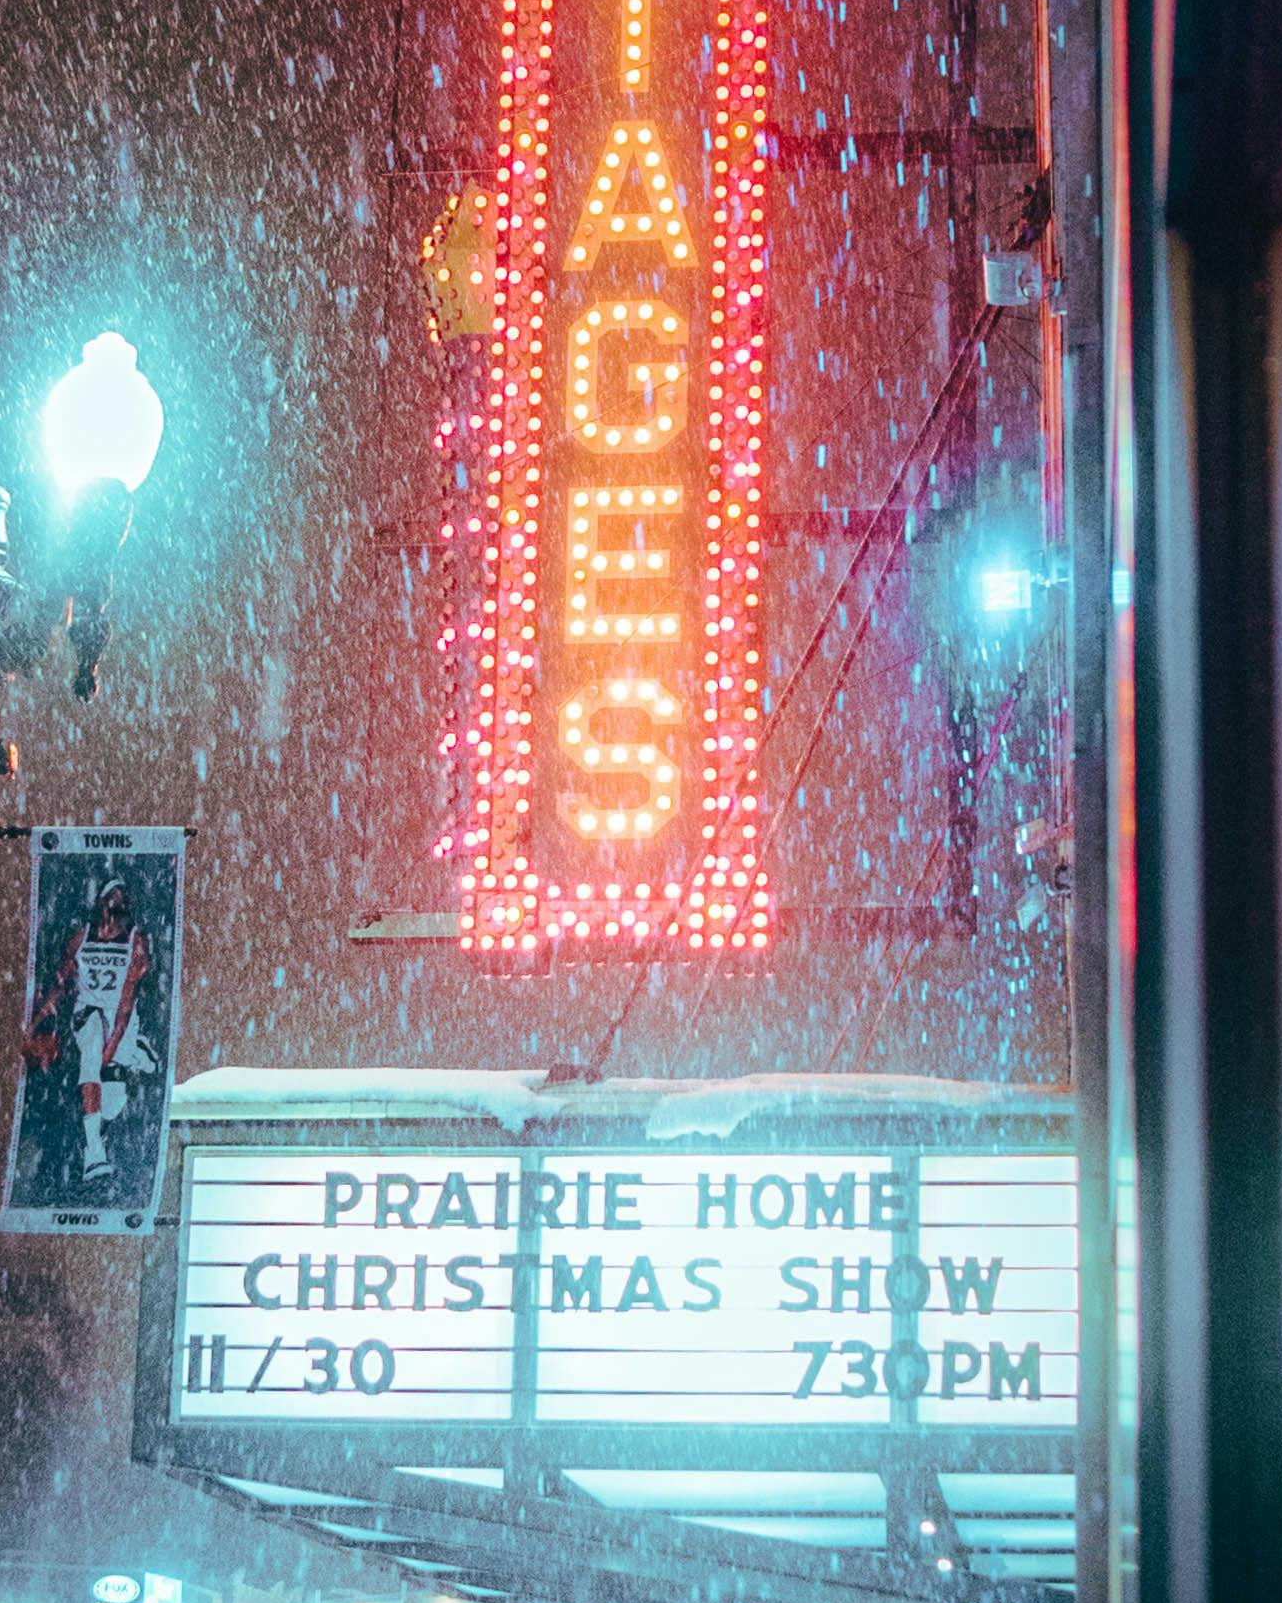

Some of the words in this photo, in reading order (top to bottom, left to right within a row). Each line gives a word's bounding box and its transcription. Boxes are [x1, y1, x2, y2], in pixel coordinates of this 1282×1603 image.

[83, 832, 134, 849] TOWNS
[81, 953, 128, 969] WOLVES
[87, 969, 118, 991] 32
[322, 1171, 643, 1231] PRAIRIE
[697, 1172, 911, 1231] HOME
[50, 1212, 100, 1227] TOWNS
[243, 1252, 722, 1313] CHRISTMAS
[779, 1254, 1004, 1316] SHOW
[186, 1333, 396, 1396] 11/30
